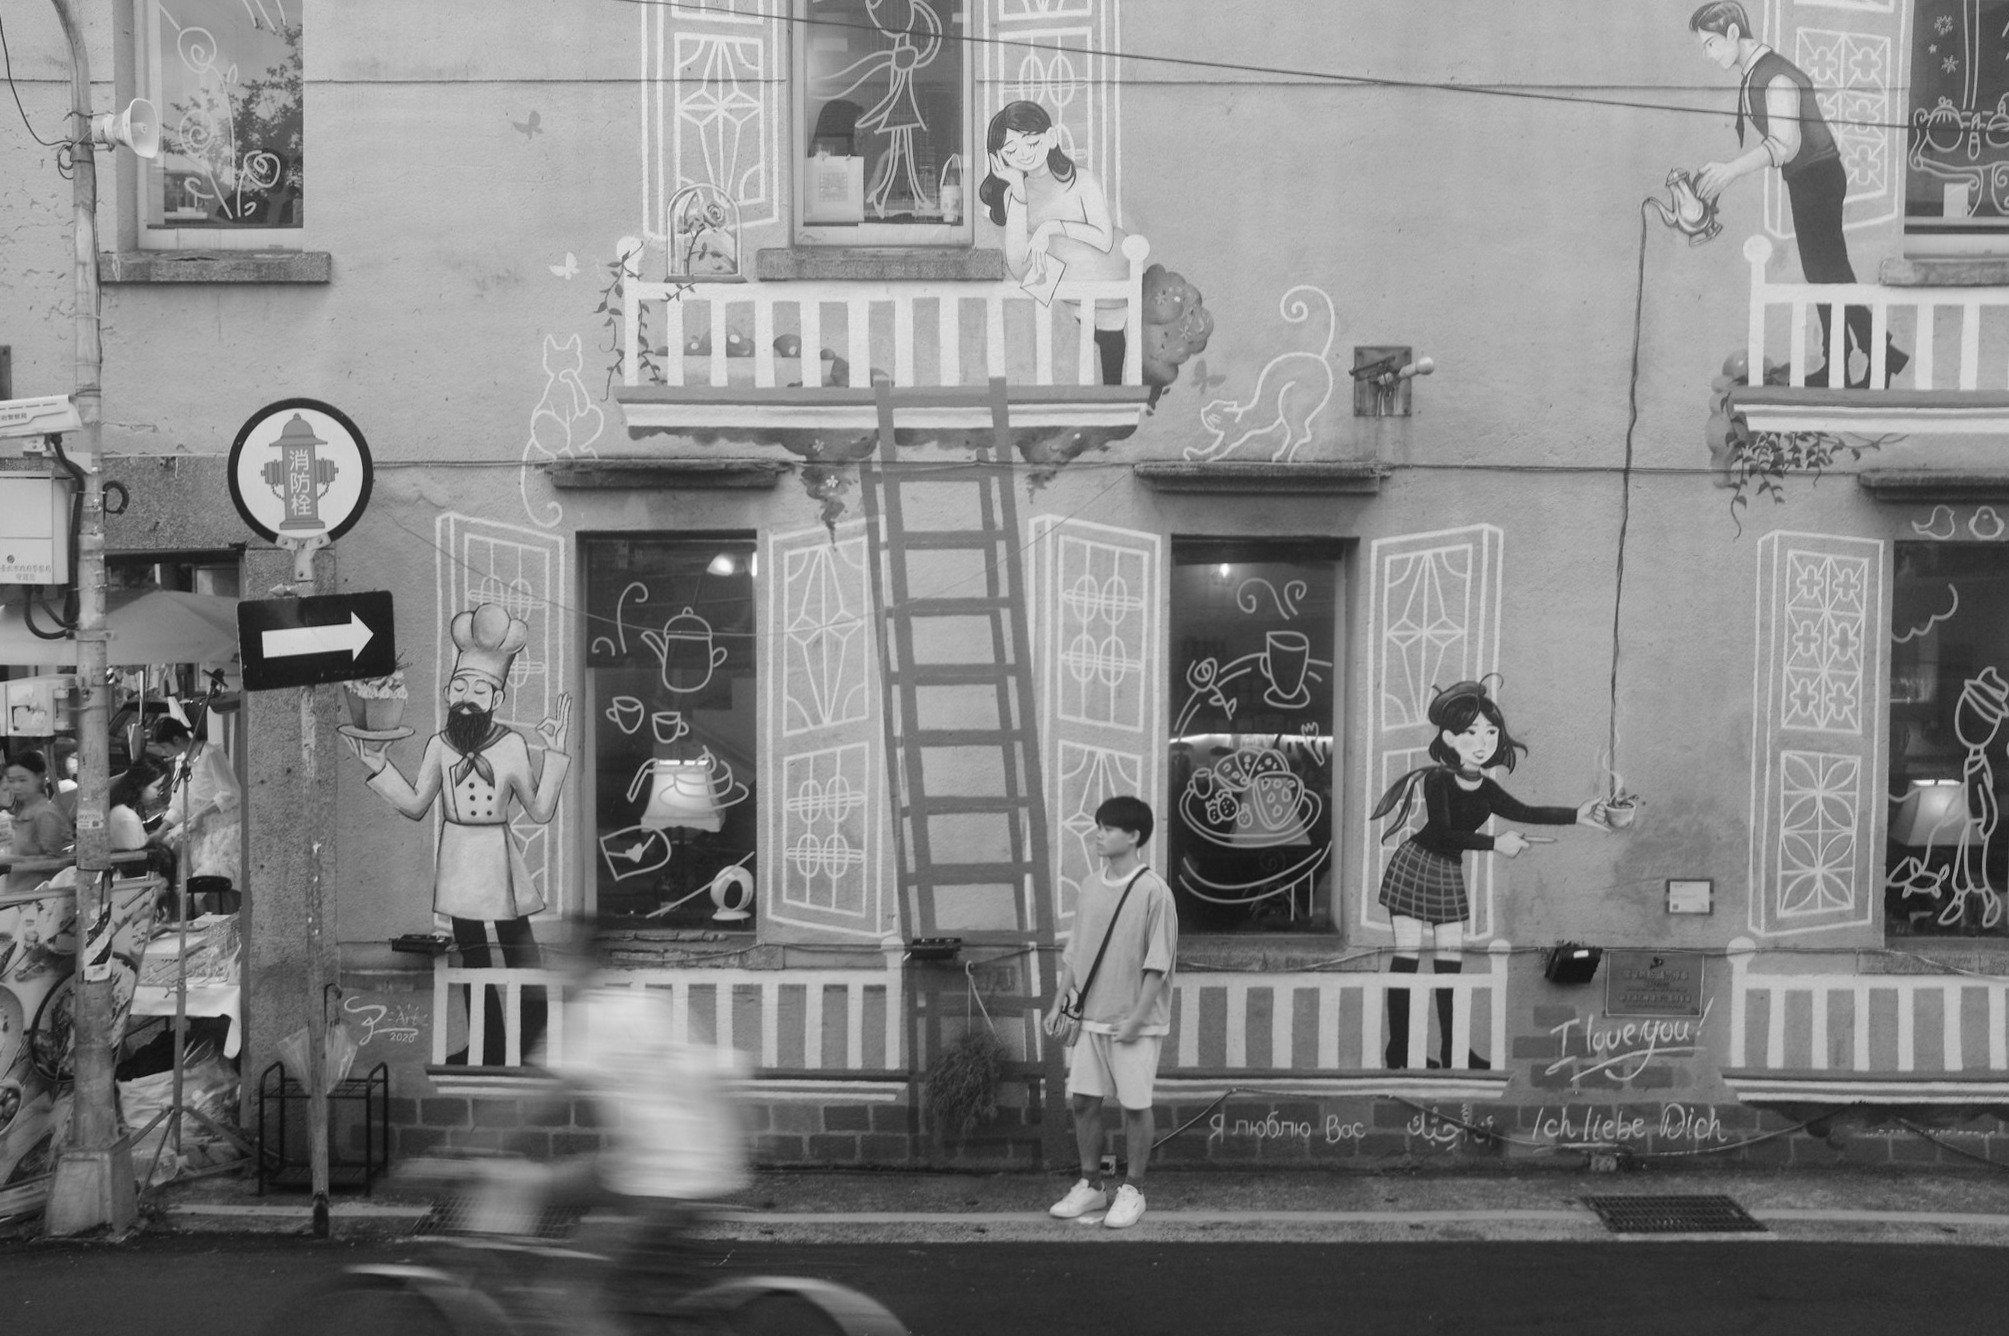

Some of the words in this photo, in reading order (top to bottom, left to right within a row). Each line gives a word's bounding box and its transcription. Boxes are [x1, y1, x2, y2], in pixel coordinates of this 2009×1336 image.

[290, 449, 312, 516] 消防栓
[1545, 1018, 1580, 1076] I
[1587, 1014, 1634, 1053] love
[1209, 1113, 1225, 1145] Я
[1232, 1110, 1311, 1139] люблю
[1325, 1114, 1366, 1144] Вас
[1532, 1106, 1576, 1140] Ich
[1583, 1106, 1645, 1141] liebe
[1660, 1102, 1727, 1143] Dich
